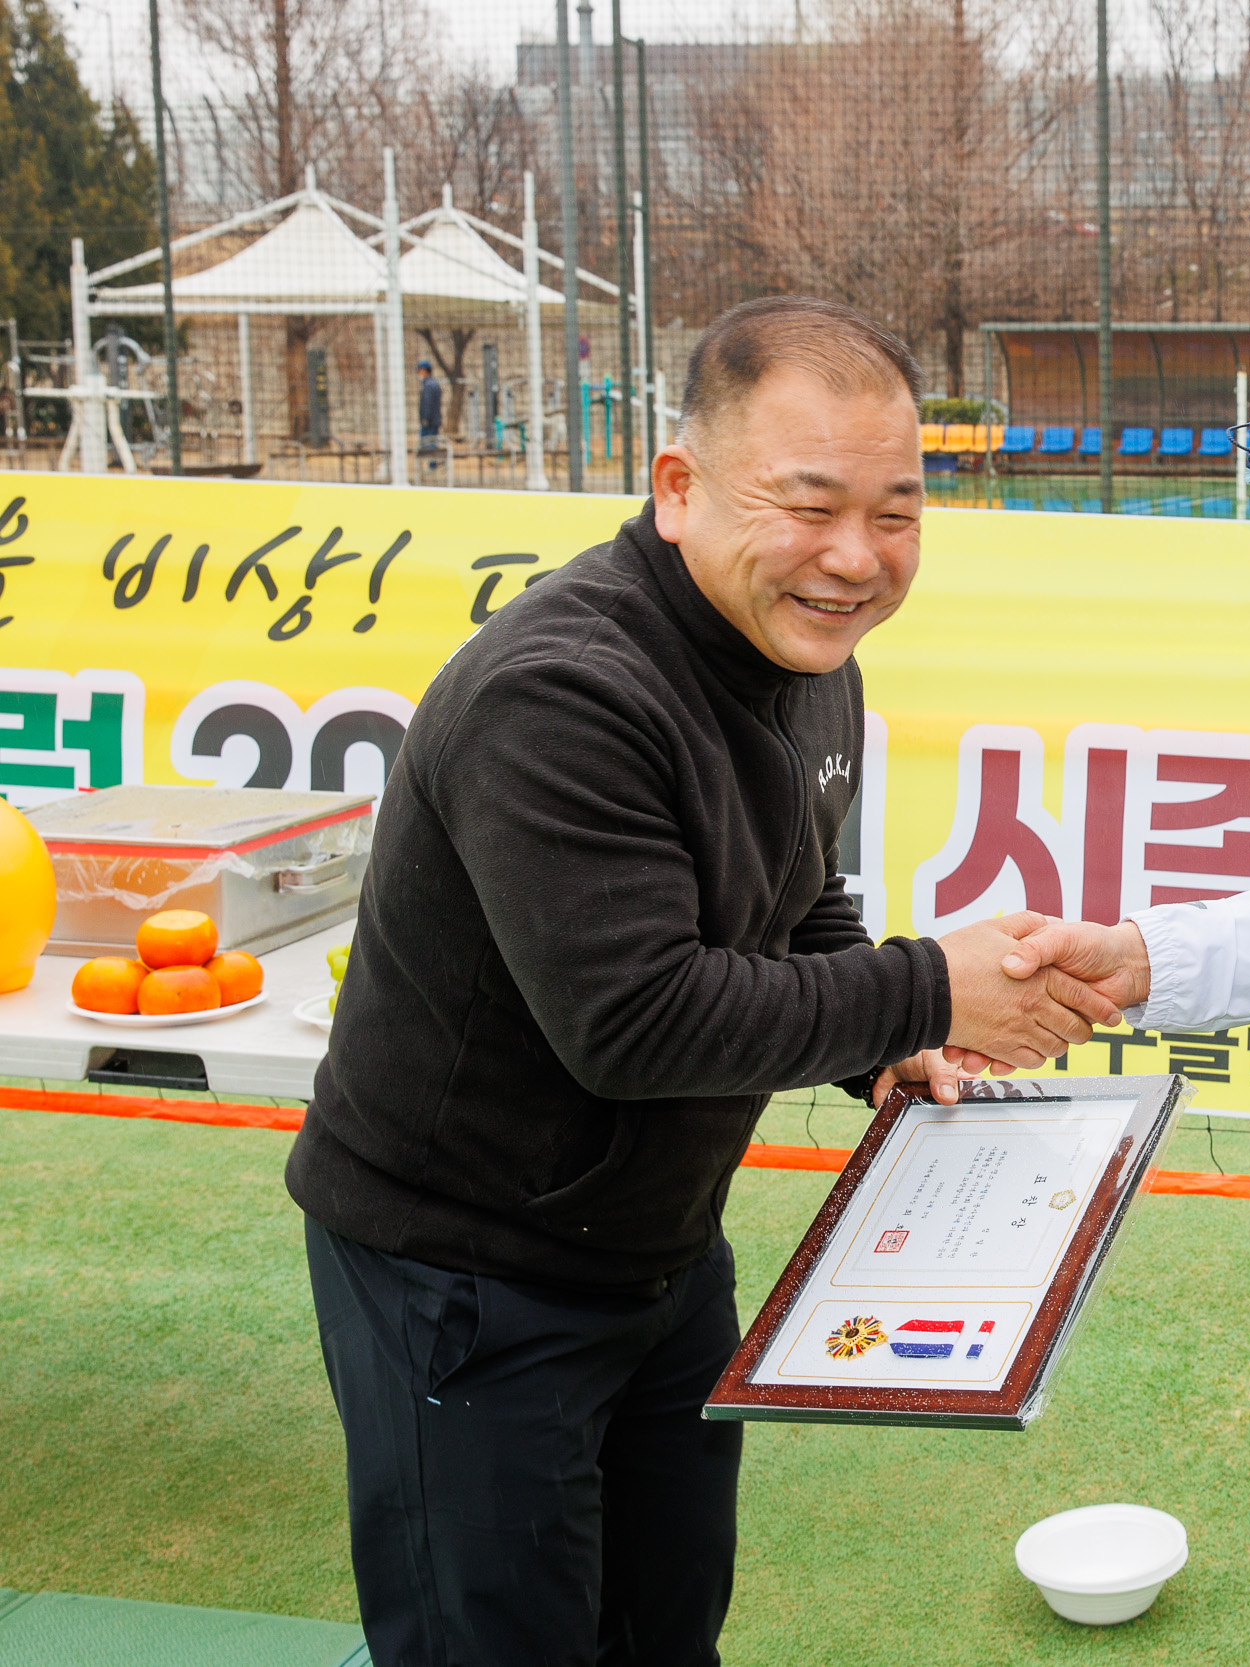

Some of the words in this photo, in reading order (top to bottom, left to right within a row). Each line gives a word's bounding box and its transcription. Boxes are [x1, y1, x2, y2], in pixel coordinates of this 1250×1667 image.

[103, 525, 412, 641] 비상!
[1033, 1173, 1047, 1184] 표
[1021, 1195, 1037, 1206] 창
[1010, 1217, 1026, 1228] 장
